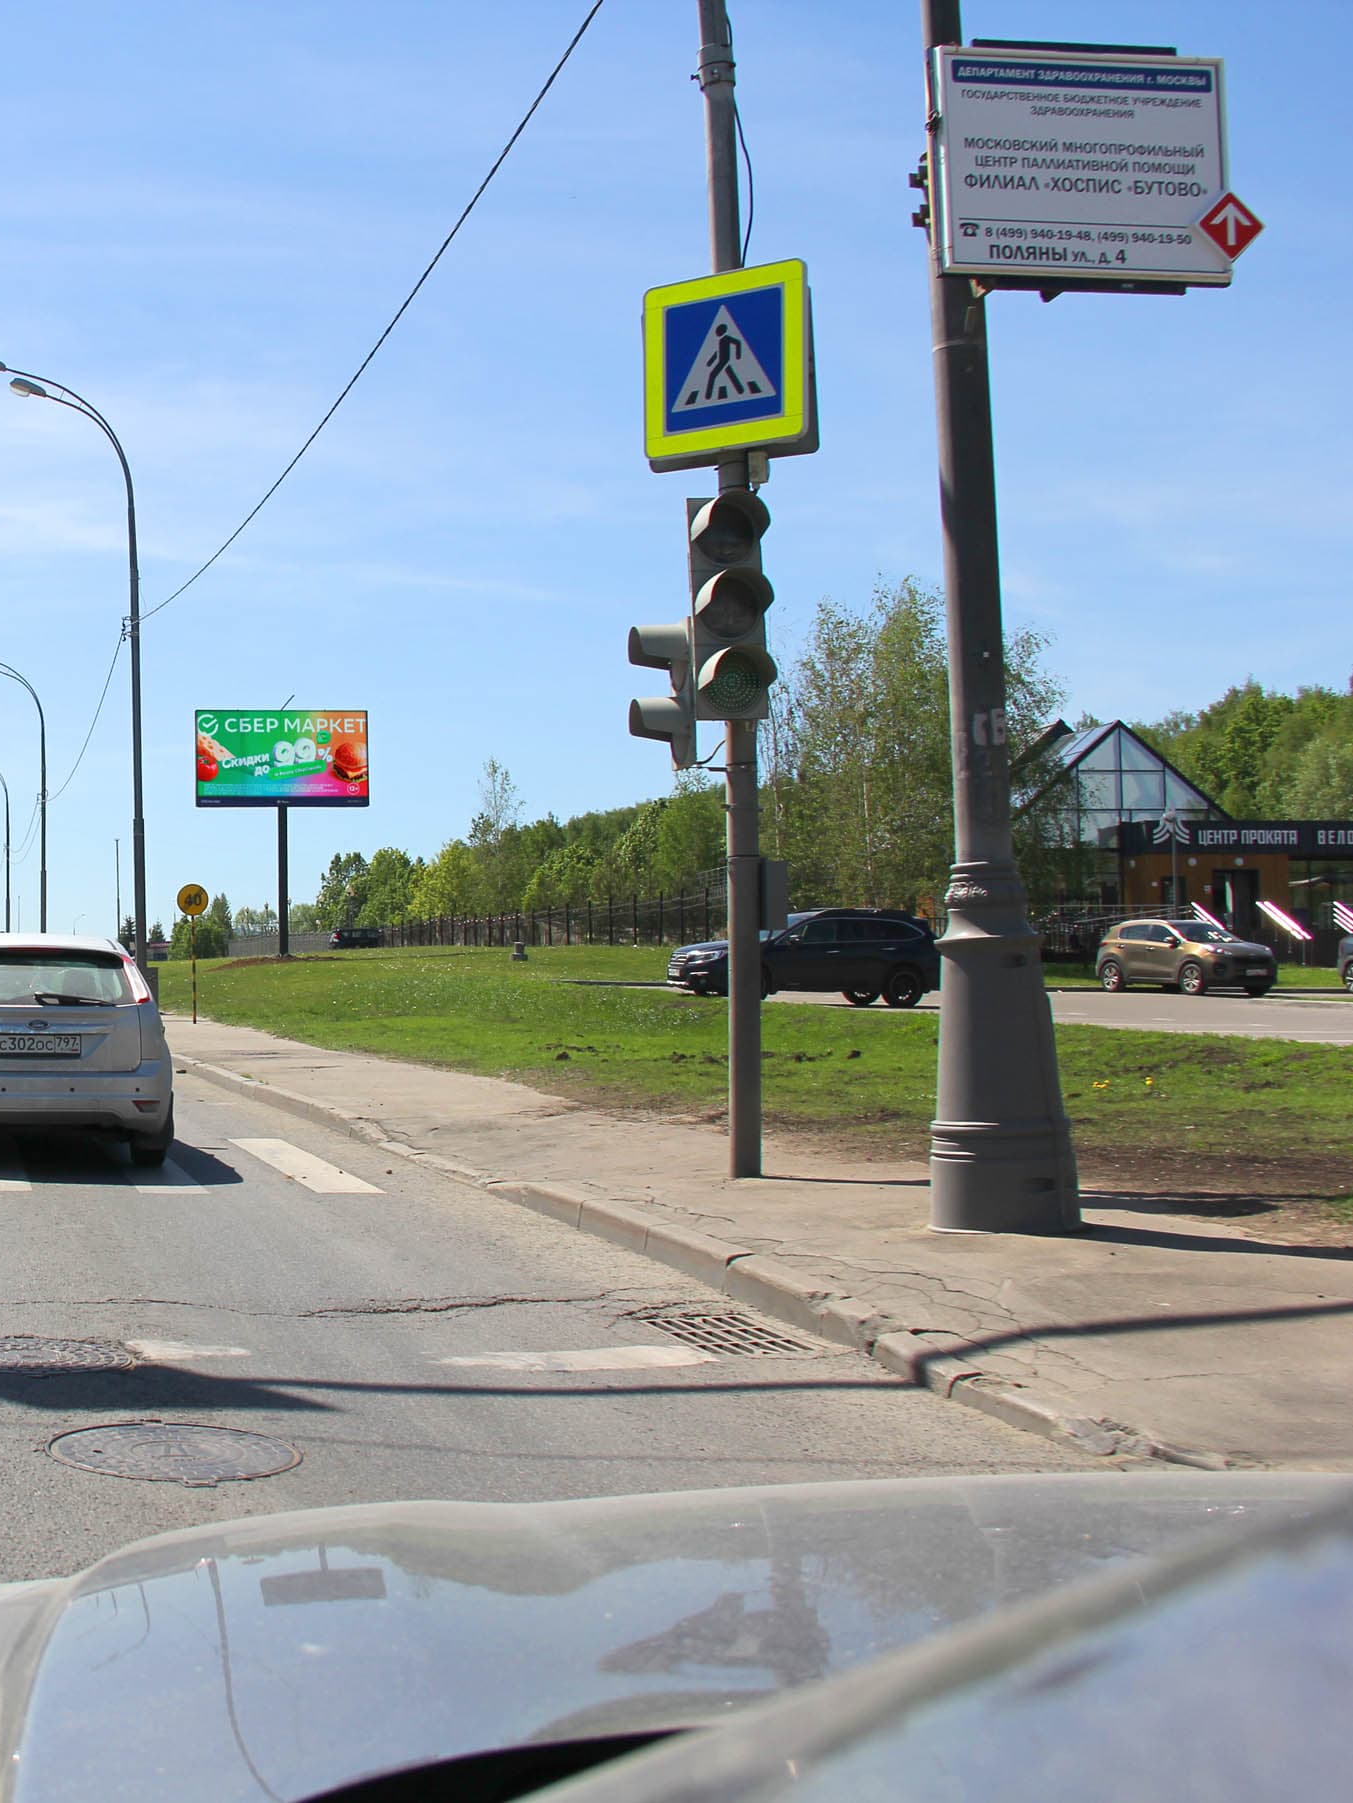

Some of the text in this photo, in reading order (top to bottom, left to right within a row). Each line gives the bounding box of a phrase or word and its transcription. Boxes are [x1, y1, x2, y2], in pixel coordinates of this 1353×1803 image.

[956, 66, 1036, 79] ДЕПАРТАМЕНТ
[1037, 69, 1145, 84] ЗДРАВООХРАНЕНИЯ
[1156, 74, 1207, 87] МОСКВЫ
[960, 88, 1201, 109] ГОСУДАРСТВЕННОЕ БЮДЖЕТНОЕ УЧРЕЖДЕНИЕ
[1030, 105, 1135, 119] ЗДРАВООХРАНЕНИЯ
[963, 137, 1205, 158] МОСКОВСКИЙ МНОГОПРОФИЛЬНЫЙ
[975, 155, 1196, 176] ЦЕНТР ПАЛЛИАТИВНОЙ ПОМОЩИ
[964, 173, 1040, 190] ФИЛИАЛ
[984, 226, 993, 238] 8
[995, 227, 1028, 241] (499)
[1097, 230, 1129, 244] (499)
[1131, 232, 1192, 245] 940-19-50
[989, 244, 1067, 262] ПОЛЯНЫ
[1115, 249, 1127, 264] 4
[224, 717, 367, 734] СБЕР МАРКЕТ
[254, 765, 270, 777] до
[1198, 829, 1238, 846] ЦЕНТР
[1241, 829, 1298, 845] ПРОКАТА
